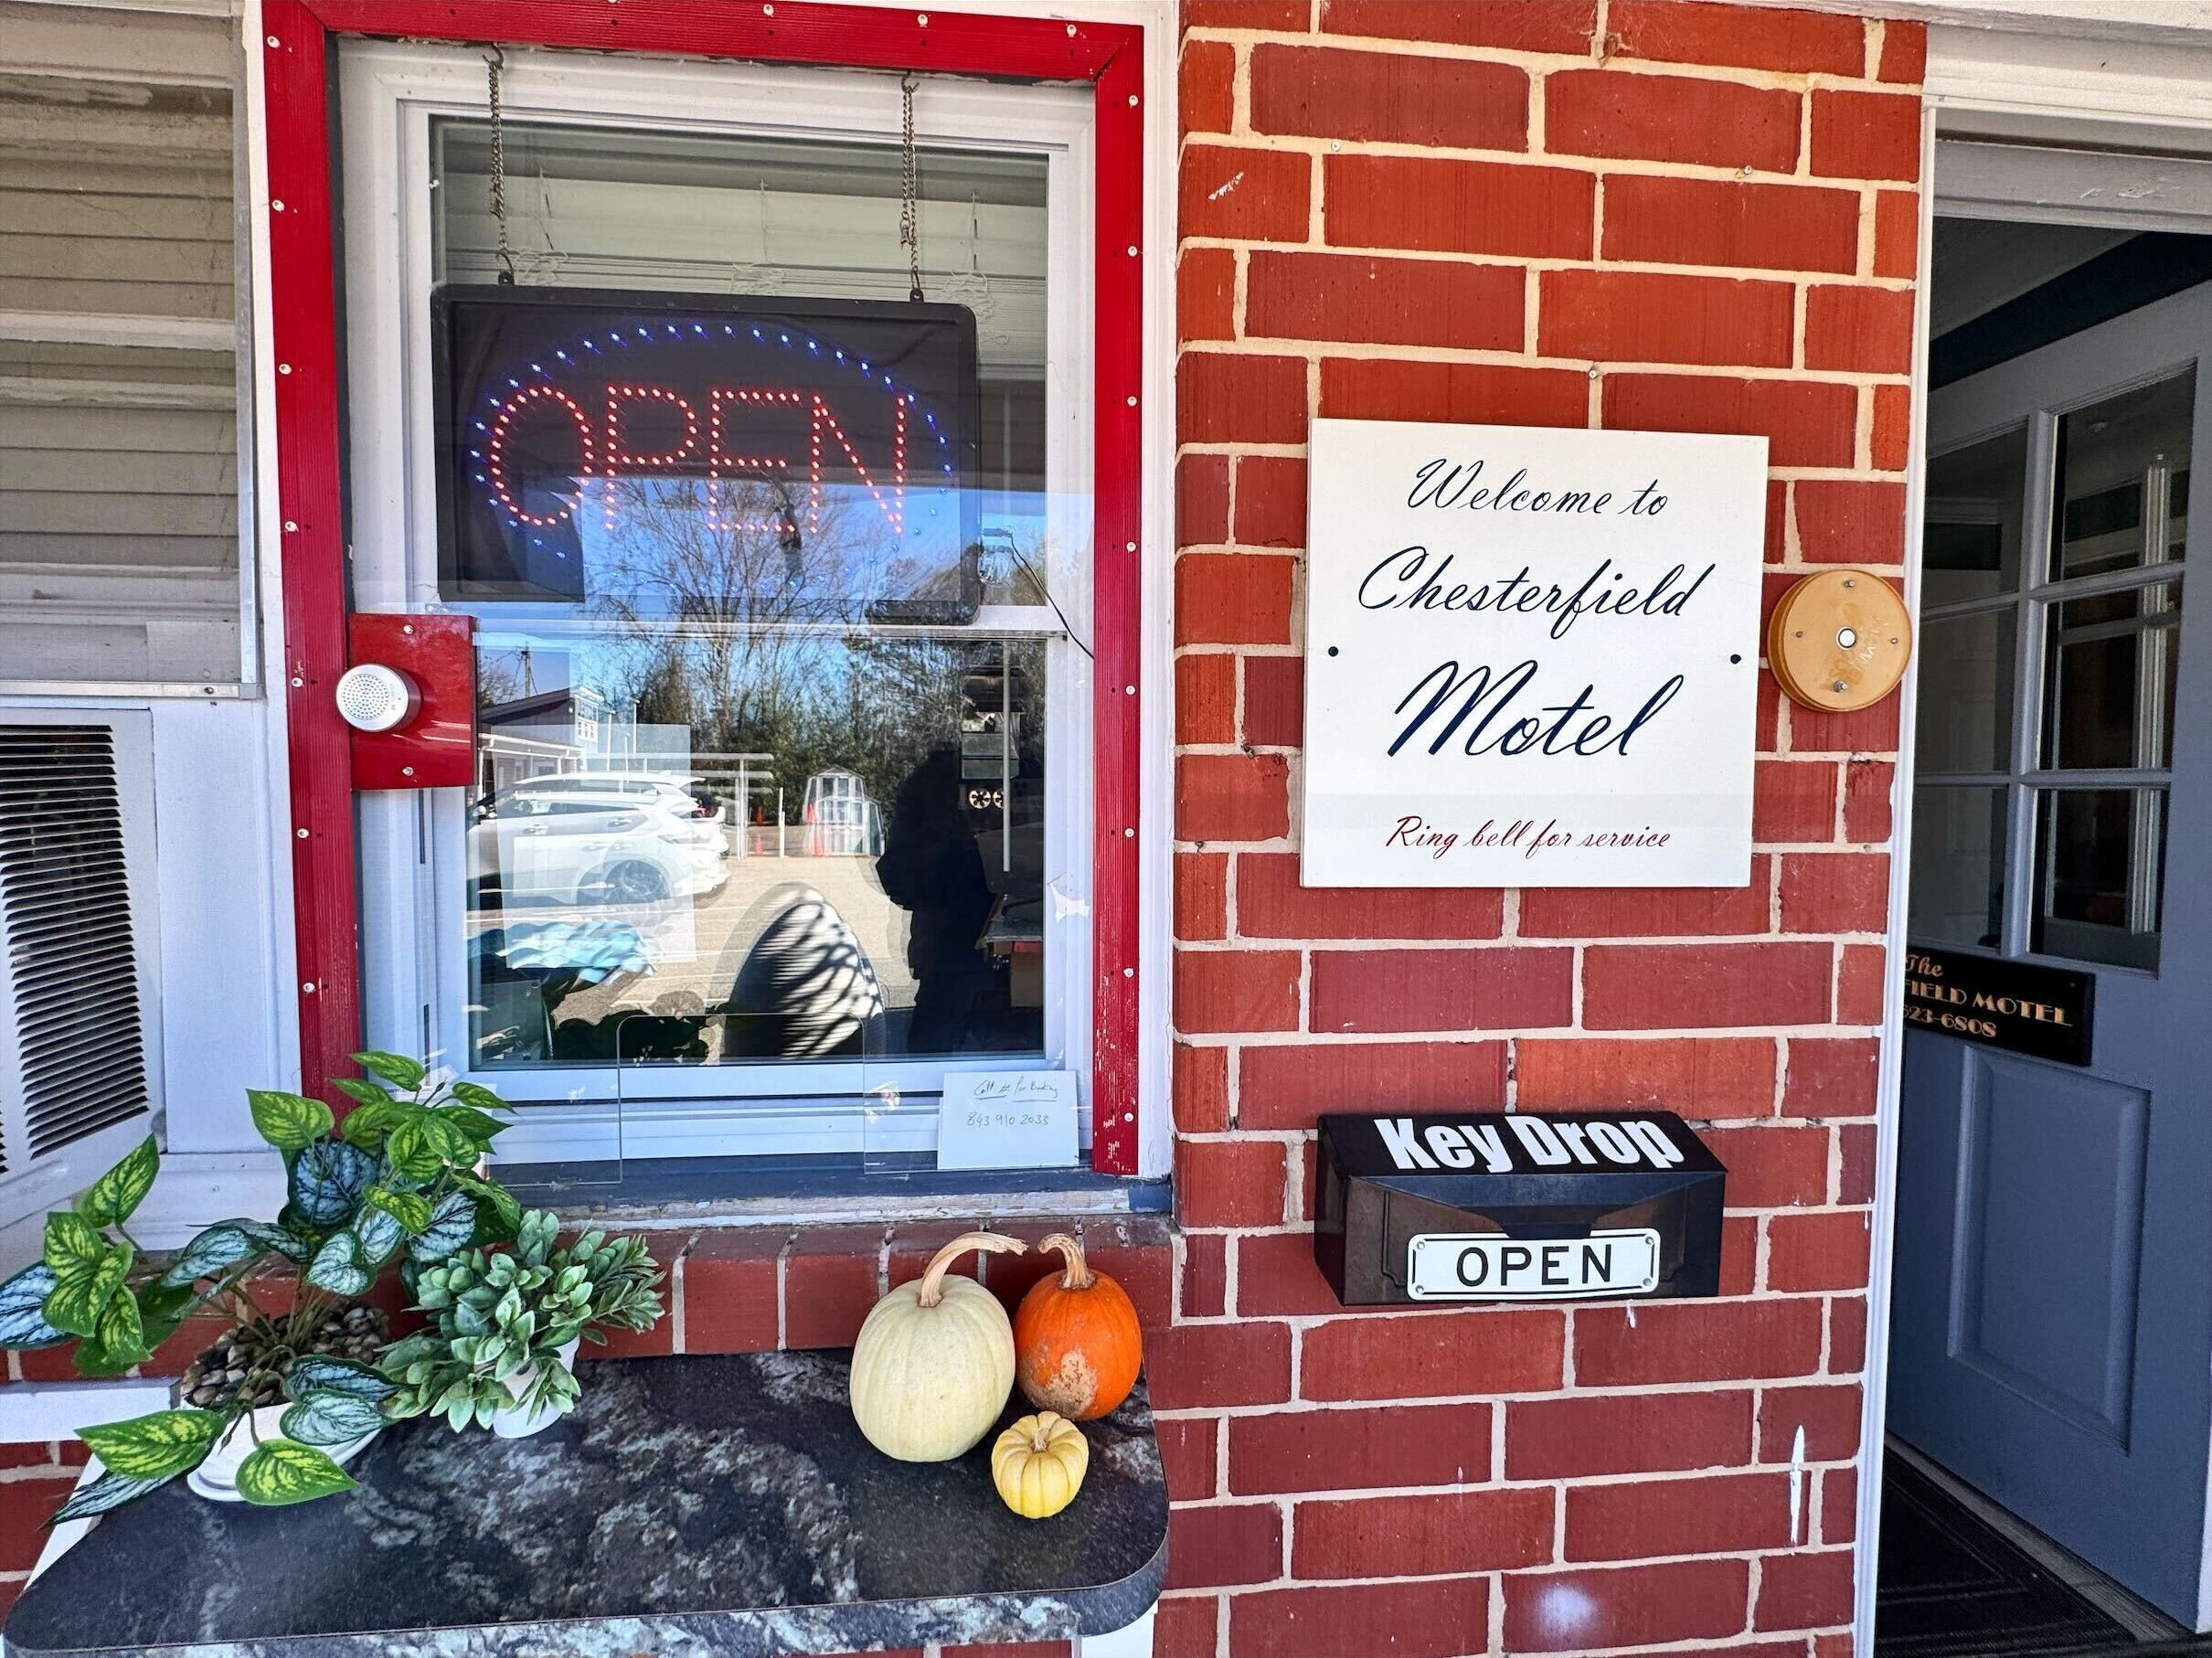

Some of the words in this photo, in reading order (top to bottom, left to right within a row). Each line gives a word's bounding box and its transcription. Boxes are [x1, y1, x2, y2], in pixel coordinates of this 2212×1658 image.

[489, 384, 907, 536] OPEN
[1407, 458, 1612, 514] Welcome
[1618, 478, 1669, 515] to
[1357, 546, 1716, 640] Chesterfield
[1387, 659, 1685, 758] Motel
[1385, 815, 1459, 859] Ring
[1463, 819, 1524, 848] bell
[1525, 819, 1574, 859] for
[1579, 828, 1671, 849] service
[1906, 955, 1943, 976] The
[1973, 993, 2073, 1026] MOTEL
[967, 1111, 990, 1129] 843
[1374, 1118, 1514, 1173] Key
[1504, 1115, 1685, 1169] Drop
[1456, 1244, 1611, 1287] OPEN
